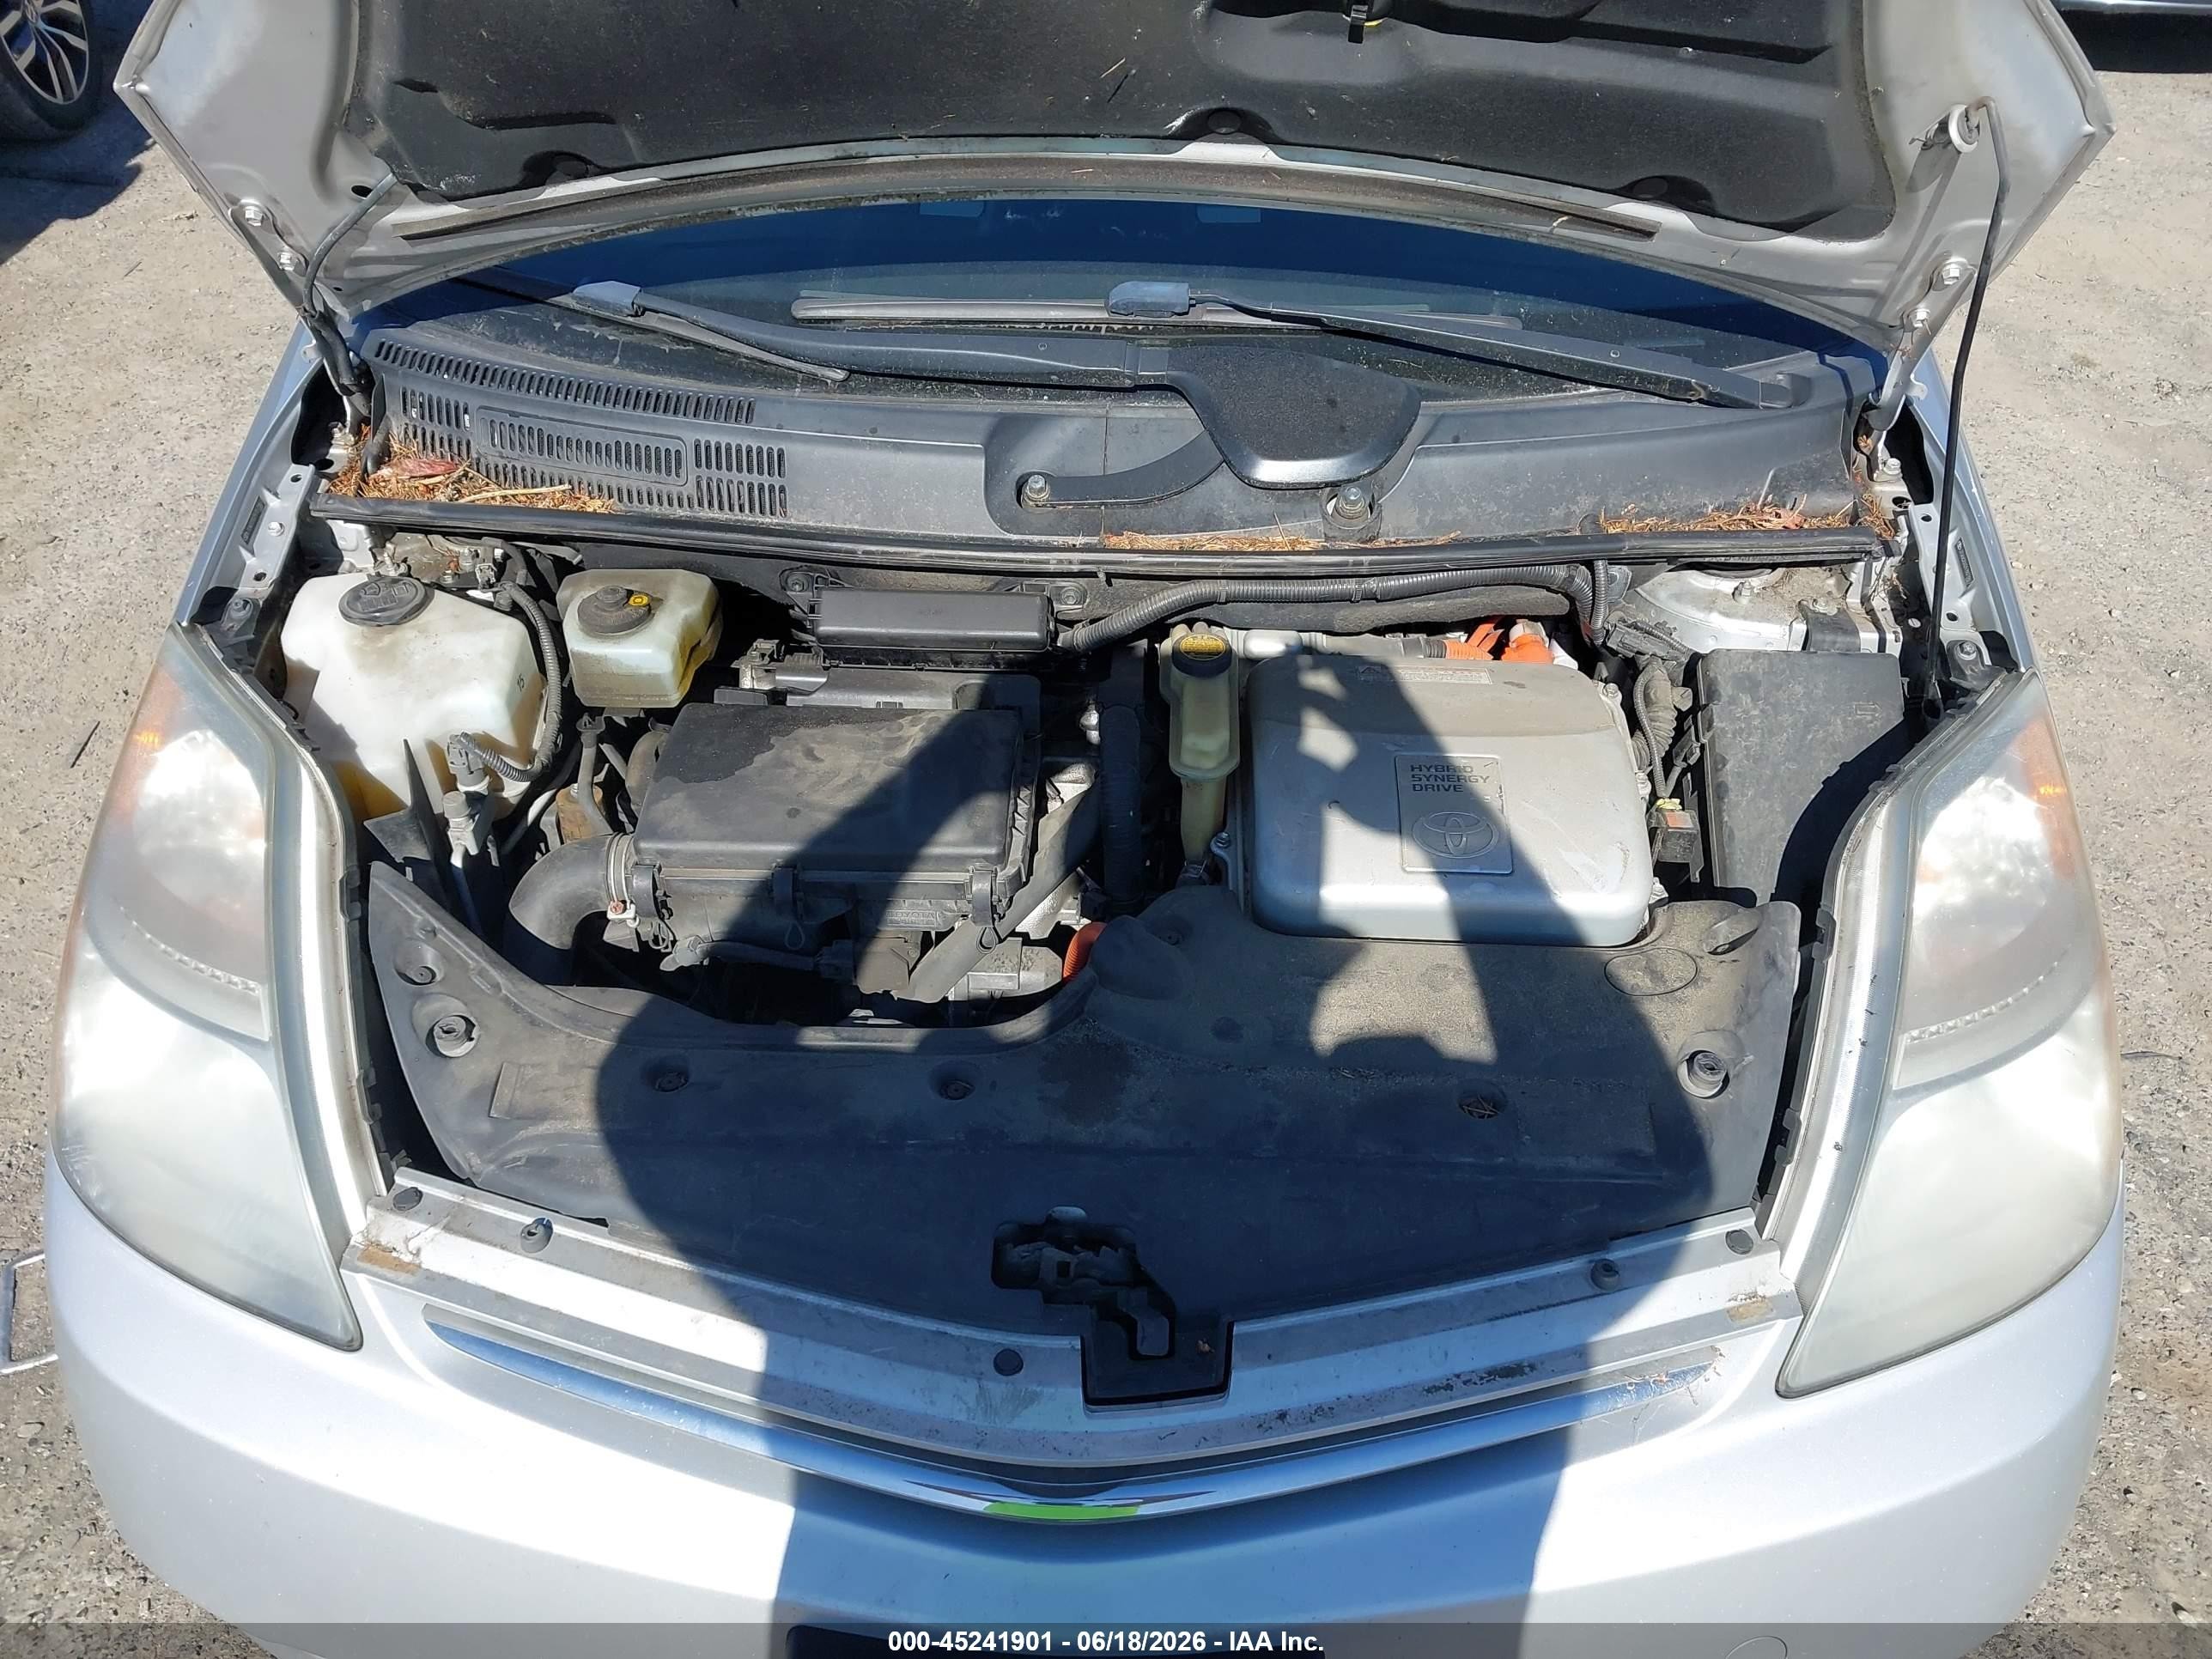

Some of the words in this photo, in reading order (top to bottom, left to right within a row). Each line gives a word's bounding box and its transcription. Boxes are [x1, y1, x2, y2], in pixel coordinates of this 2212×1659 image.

[1410, 764, 1474, 774] HYBRID
[1411, 774, 1490, 783] SYNERGY
[1413, 783, 1463, 793] DRIVE
